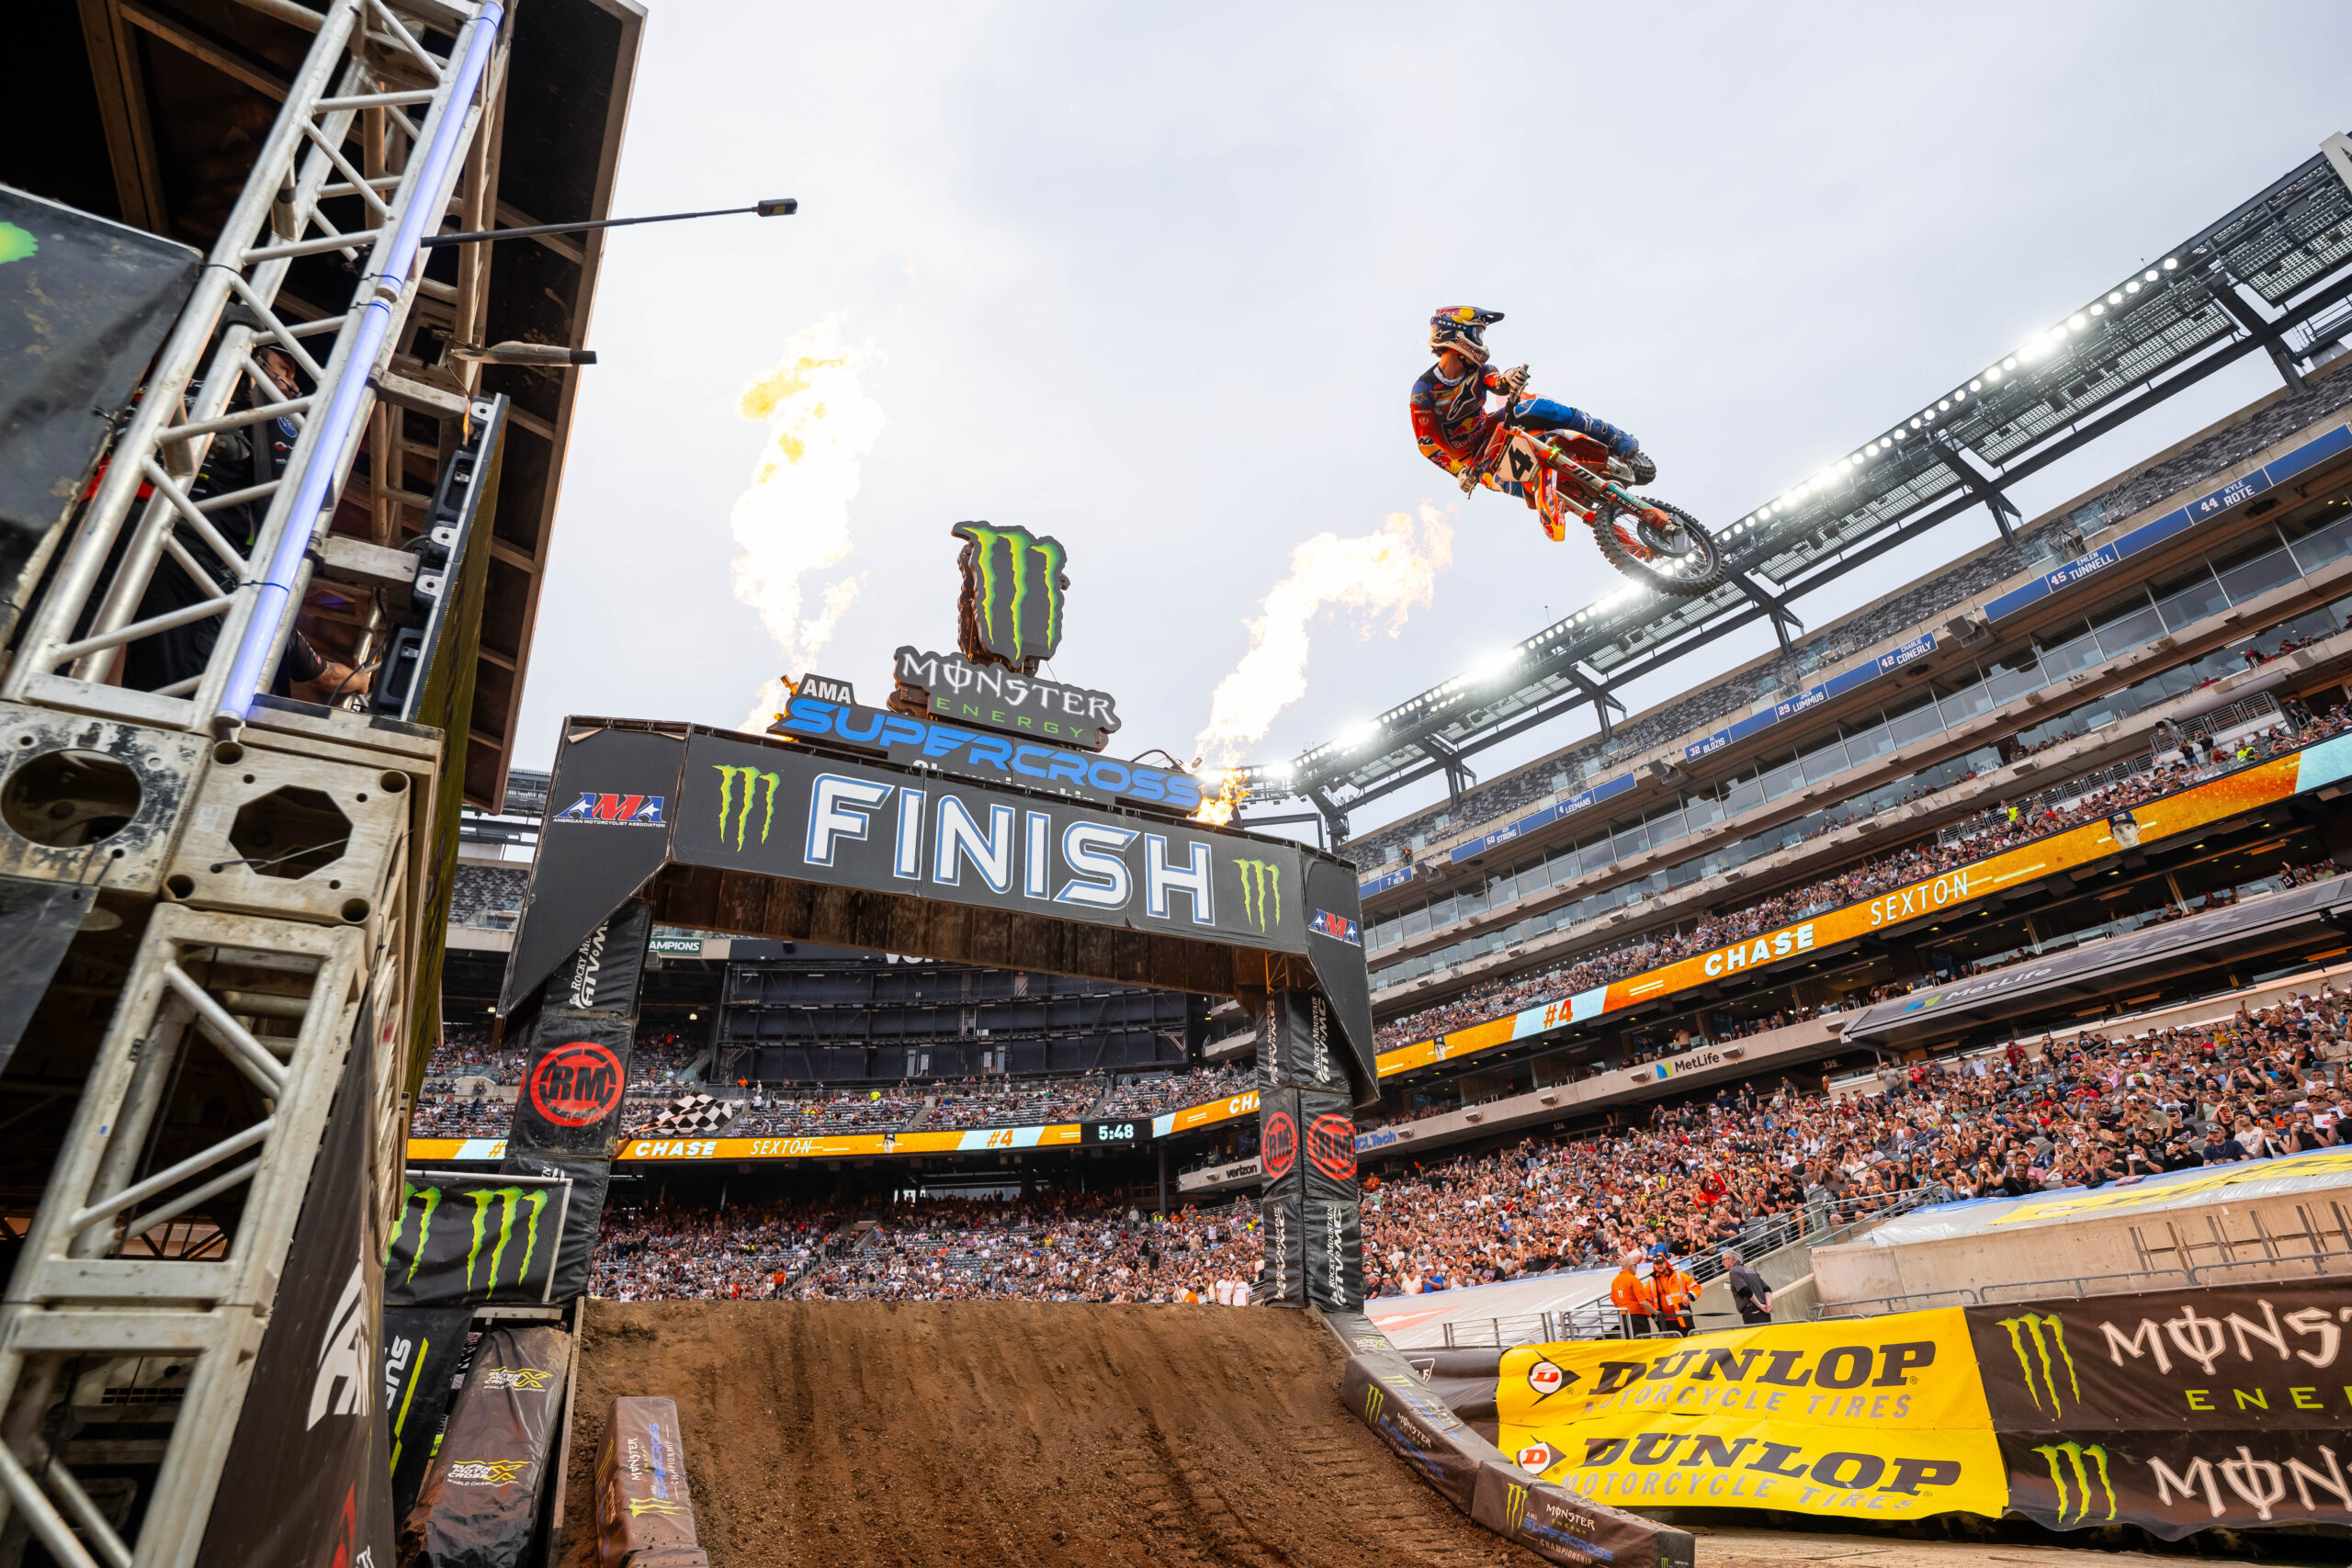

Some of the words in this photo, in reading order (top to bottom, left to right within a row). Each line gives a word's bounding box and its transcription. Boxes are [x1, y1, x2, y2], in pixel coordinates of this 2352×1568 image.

[1438, 320, 1467, 330] OAKLEY
[1508, 444, 1534, 480] 4
[2200, 497, 2220, 513] 44
[2222, 485, 2255, 506] ROTE
[2224, 480, 2244, 494] KYLE
[2051, 571, 2067, 585] 45
[2068, 554, 2114, 581] TUNNELL
[2075, 551, 2098, 566] EMLEN
[1882, 655, 1895, 668] 42
[1895, 640, 1931, 664] CONERLY
[1901, 638, 1923, 652] CHARLIE
[802, 679, 852, 705] AMA
[901, 651, 1116, 726] MONSTER
[1799, 690, 1813, 700] JACK
[1779, 704, 1791, 716] 29
[1792, 691, 1825, 713] LUMMUS
[935, 697, 1085, 739] ENERGY
[782, 698, 1202, 808] SUPERCROSS
[1690, 745, 1701, 757] 32
[1702, 737, 1726, 755] BLOZIS
[553, 792, 667, 824] AMA
[1566, 797, 1591, 814] LEEMANS
[804, 773, 1216, 927] FINISH
[1487, 836, 1495, 845] 50
[1497, 829, 1517, 843] STRONG
[1308, 908, 1361, 944] AMA
[1704, 923, 1814, 977] CHASE
[1871, 872, 1969, 927] SEXTON
[571, 954, 587, 992] ROCKY
[1945, 966, 2052, 1002] MetLife
[1311, 996, 1319, 1040] MOUNTAIN
[1543, 998, 1574, 1029] #4
[1675, 1052, 1720, 1073] MetLife
[987, 1130, 1012, 1148] #4
[1098, 1123, 1135, 1140] 5:48
[635, 1141, 718, 1156] CHASE
[750, 1140, 813, 1156] SEXTON
[1227, 1163, 1258, 1179] verizon
[1328, 1257, 1336, 1289] ROCKY
[1589, 1340, 1936, 1396] DUNLOP
[1580, 1384, 1787, 1416] MOTORCYCLE
[1807, 1393, 1912, 1419] TIRES
[2185, 1385, 2352, 1411] ENE
[1396, 1412, 1431, 1449] MONSTER
[628, 1438, 642, 1481] MONSTER
[1583, 1433, 1962, 1497] DUNLOP
[447, 1478, 470, 1486] WORLD
[1561, 1472, 1785, 1500] MOTORCYCLE
[1799, 1485, 1919, 1511] TIRES
[2146, 1445, 2352, 1520] MON
[1526, 1511, 1538, 1521] AMA
[1546, 1503, 1596, 1531] MONSTER
[1551, 1518, 1588, 1535] ENERGY
[1522, 1517, 1614, 1562] SUPERCROSS
[1540, 1538, 1593, 1566] CHAMPIONSHIP
